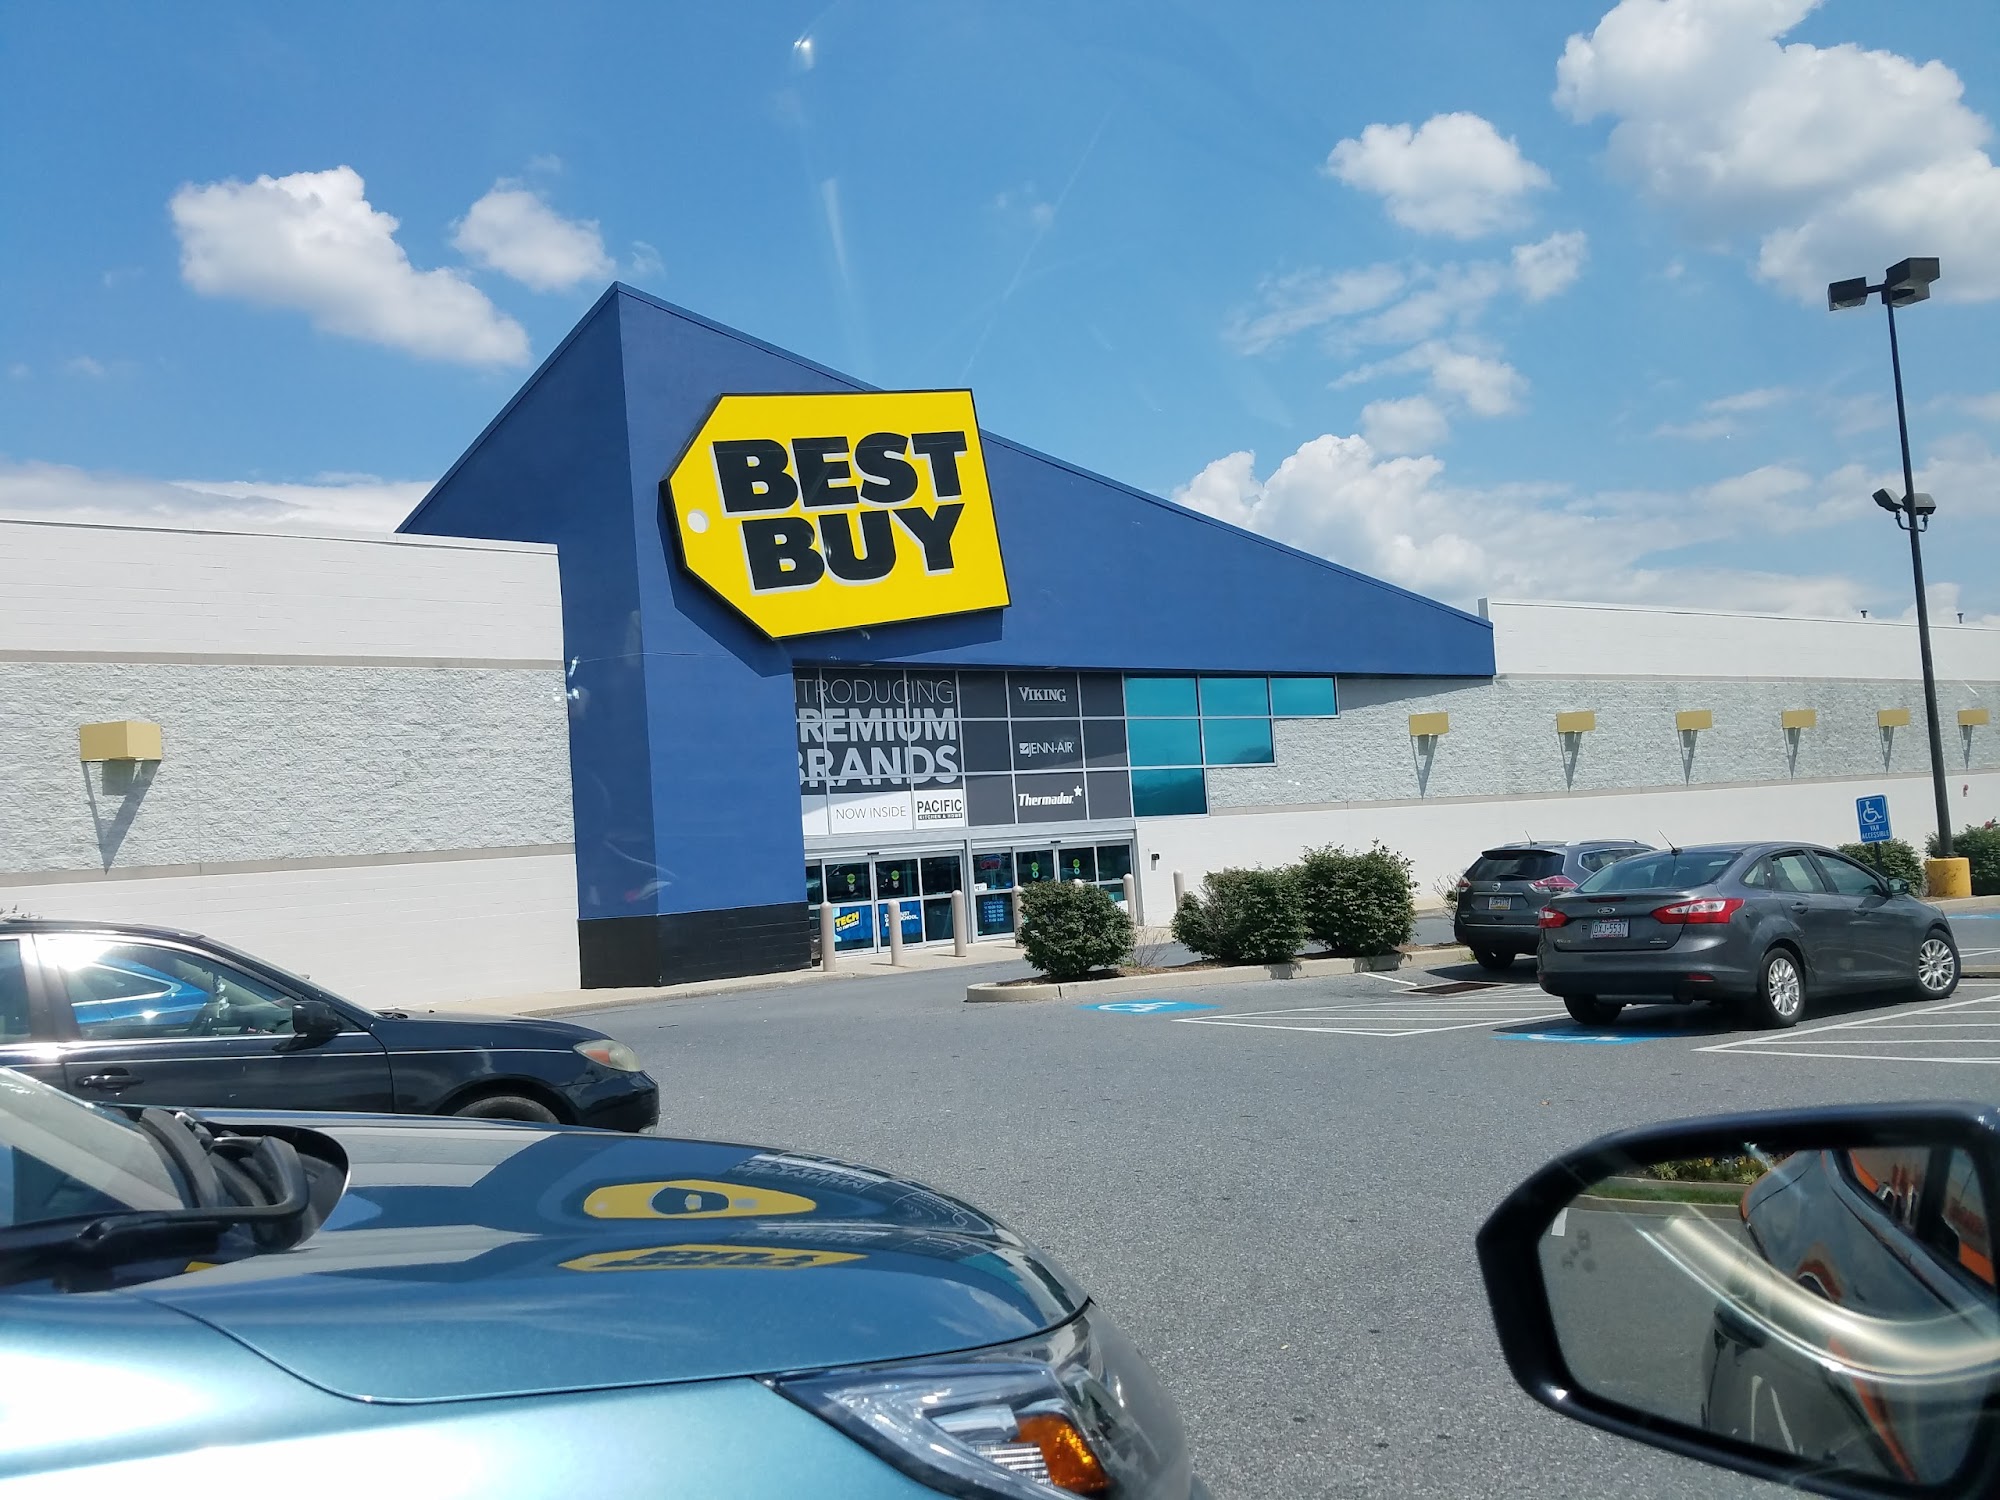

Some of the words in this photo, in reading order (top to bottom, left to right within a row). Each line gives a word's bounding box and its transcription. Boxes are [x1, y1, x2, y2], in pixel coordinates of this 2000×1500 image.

[711, 431, 968, 514] BEST
[740, 503, 966, 593] BUY
[795, 679, 954, 704] TRODUCING
[1018, 686, 1067, 702] VIKING
[797, 708, 957, 743] REMIUM
[1027, 742, 1074, 757] JENN-AIR
[917, 799, 962, 813] PACIFIC
[1018, 792, 1074, 807] Thermador
[836, 808, 866, 820] NOW
[869, 806, 907, 818] INSIDE
[1862, 830, 1889, 839] ACCESSIBLE
[835, 911, 860, 928] TECH
